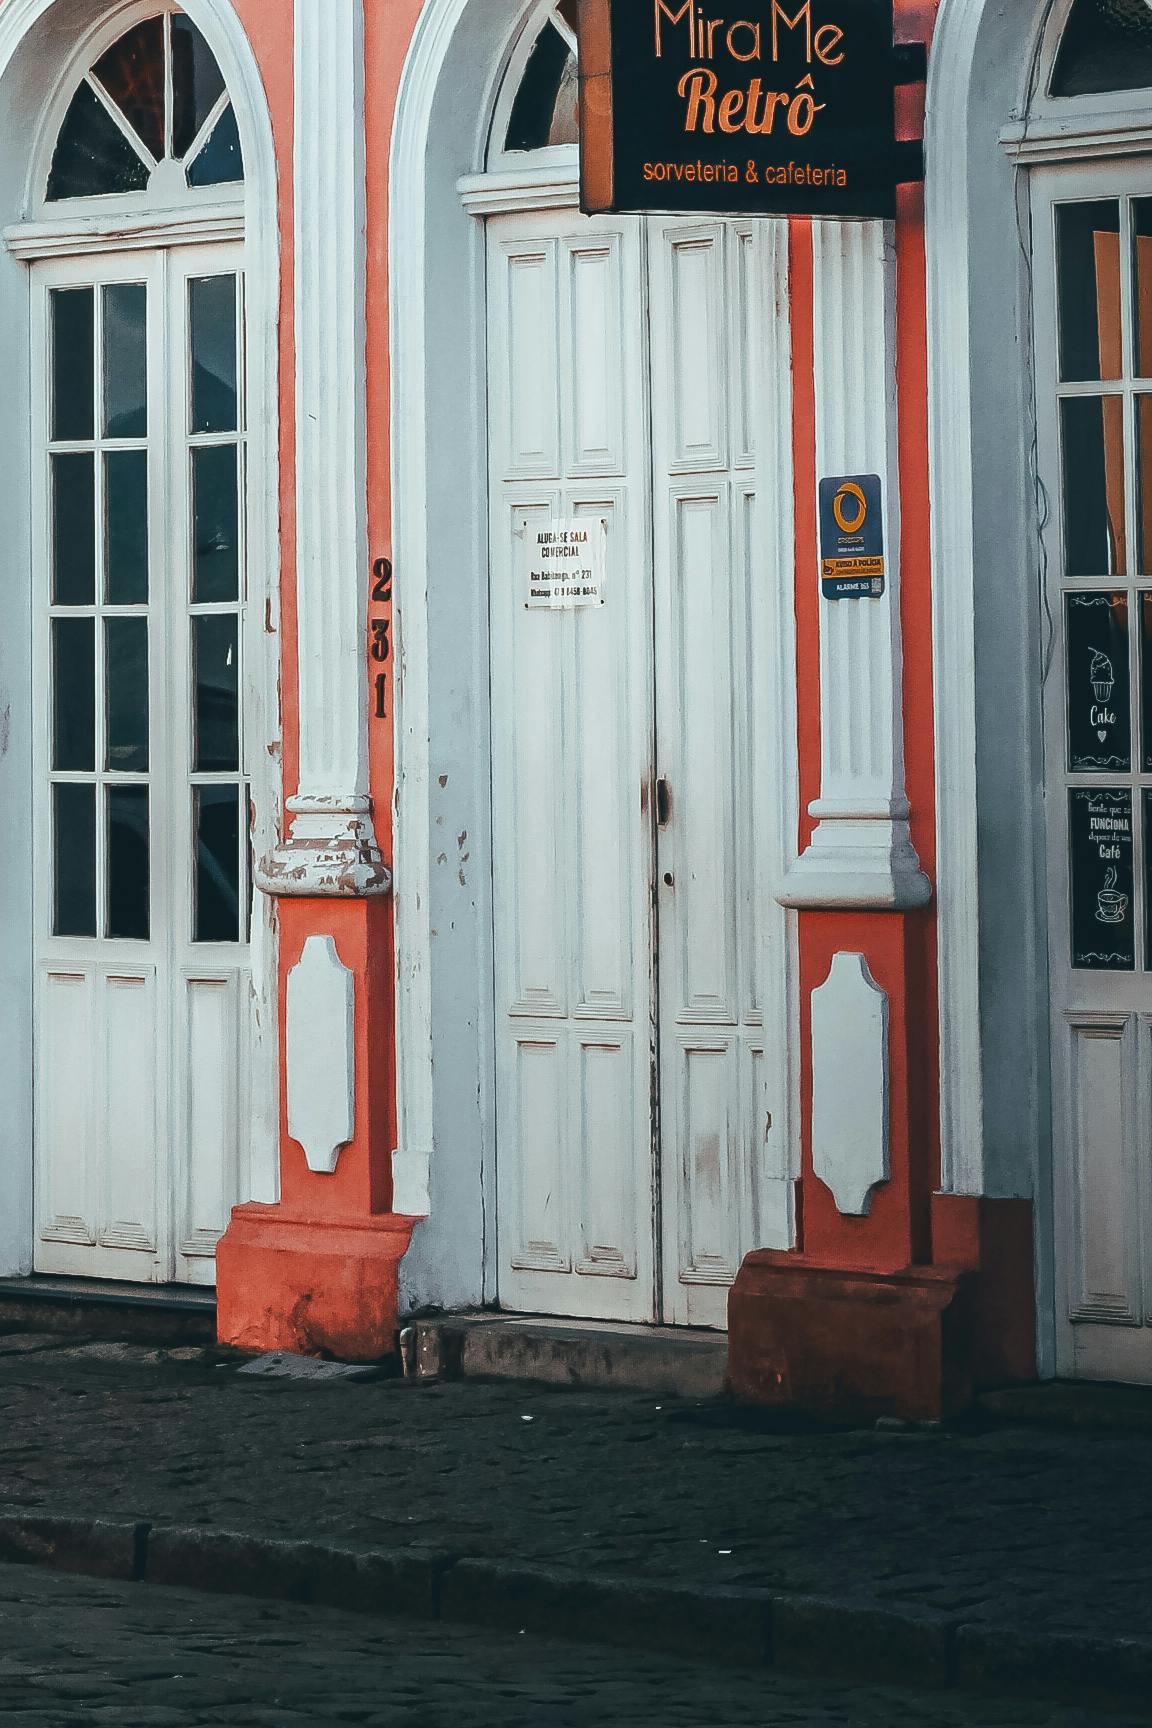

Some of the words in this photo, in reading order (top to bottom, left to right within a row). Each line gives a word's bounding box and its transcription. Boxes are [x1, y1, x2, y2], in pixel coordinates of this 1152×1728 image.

[678, 67, 826, 136] Retrô
[643, 160, 738, 183] sorveteria
[745, 160, 759, 183] &
[765, 161, 847, 186] cafeteria
[570, 531, 588, 543] SALA
[542, 547, 579, 558] COMERCIAL
[582, 570, 592, 580] 231
[371, 557, 392, 718] 231
[1090, 705, 1116, 726] Cake
[1090, 817, 1129, 831] FUNCIONA
[1099, 844, 1121, 859] Café
